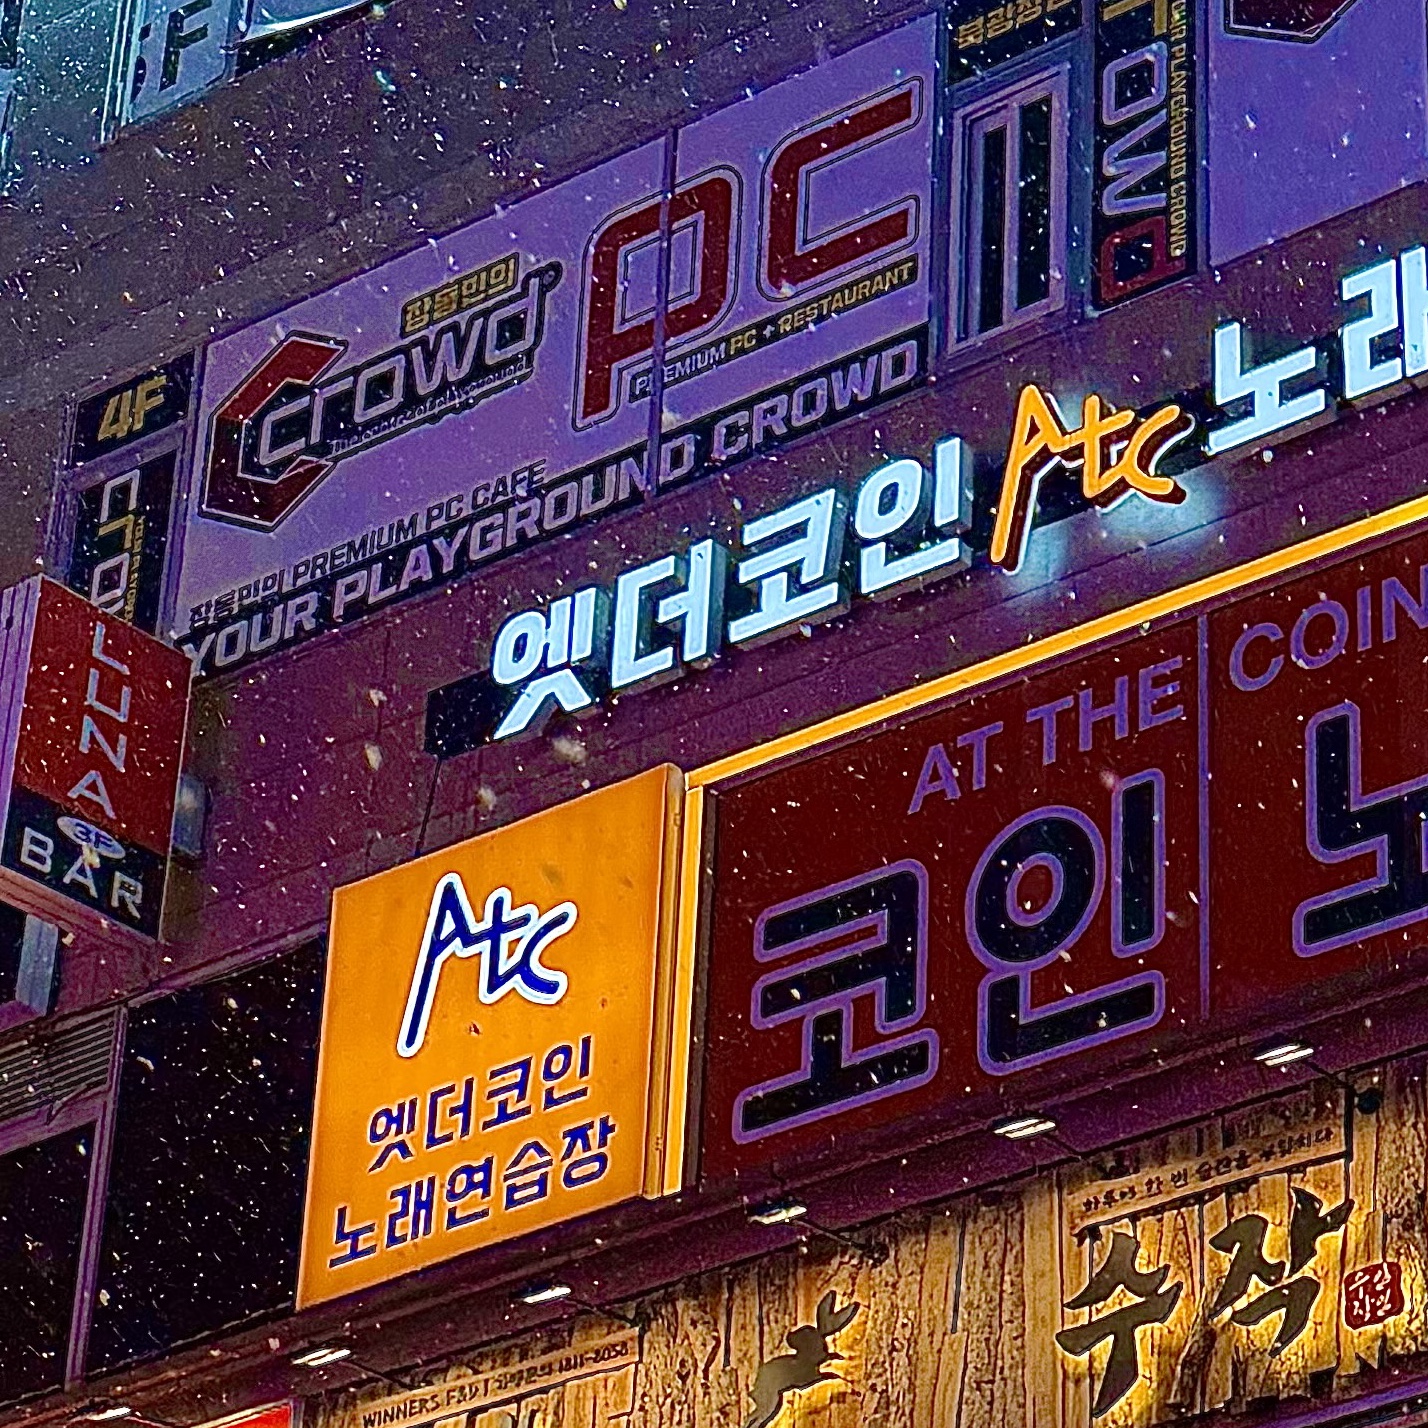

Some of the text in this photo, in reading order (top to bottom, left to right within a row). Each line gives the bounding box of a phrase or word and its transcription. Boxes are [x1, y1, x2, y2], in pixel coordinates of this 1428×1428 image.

[730, 329, 756, 355] PC
[777, 261, 914, 334] RESTAURANT
[97, 375, 167, 441] 4F
[990, 384, 1183, 564] Atc
[183, 338, 918, 677] YOUR PLAYGROUND CROWD
[292, 513, 419, 588] PREMIUM
[424, 494, 465, 530] PC
[471, 458, 548, 508] CAFE
[66, 621, 132, 820] LUNA
[908, 722, 1005, 814] AT
[1026, 657, 1184, 765] THE
[20, 827, 143, 918] BAR
[731, 766, 1166, 1145] 코인
[401, 876, 577, 1056] Atc
[327, 1116, 617, 1268] 노래연습장
[1055, 1186, 1356, 1420] 수작
